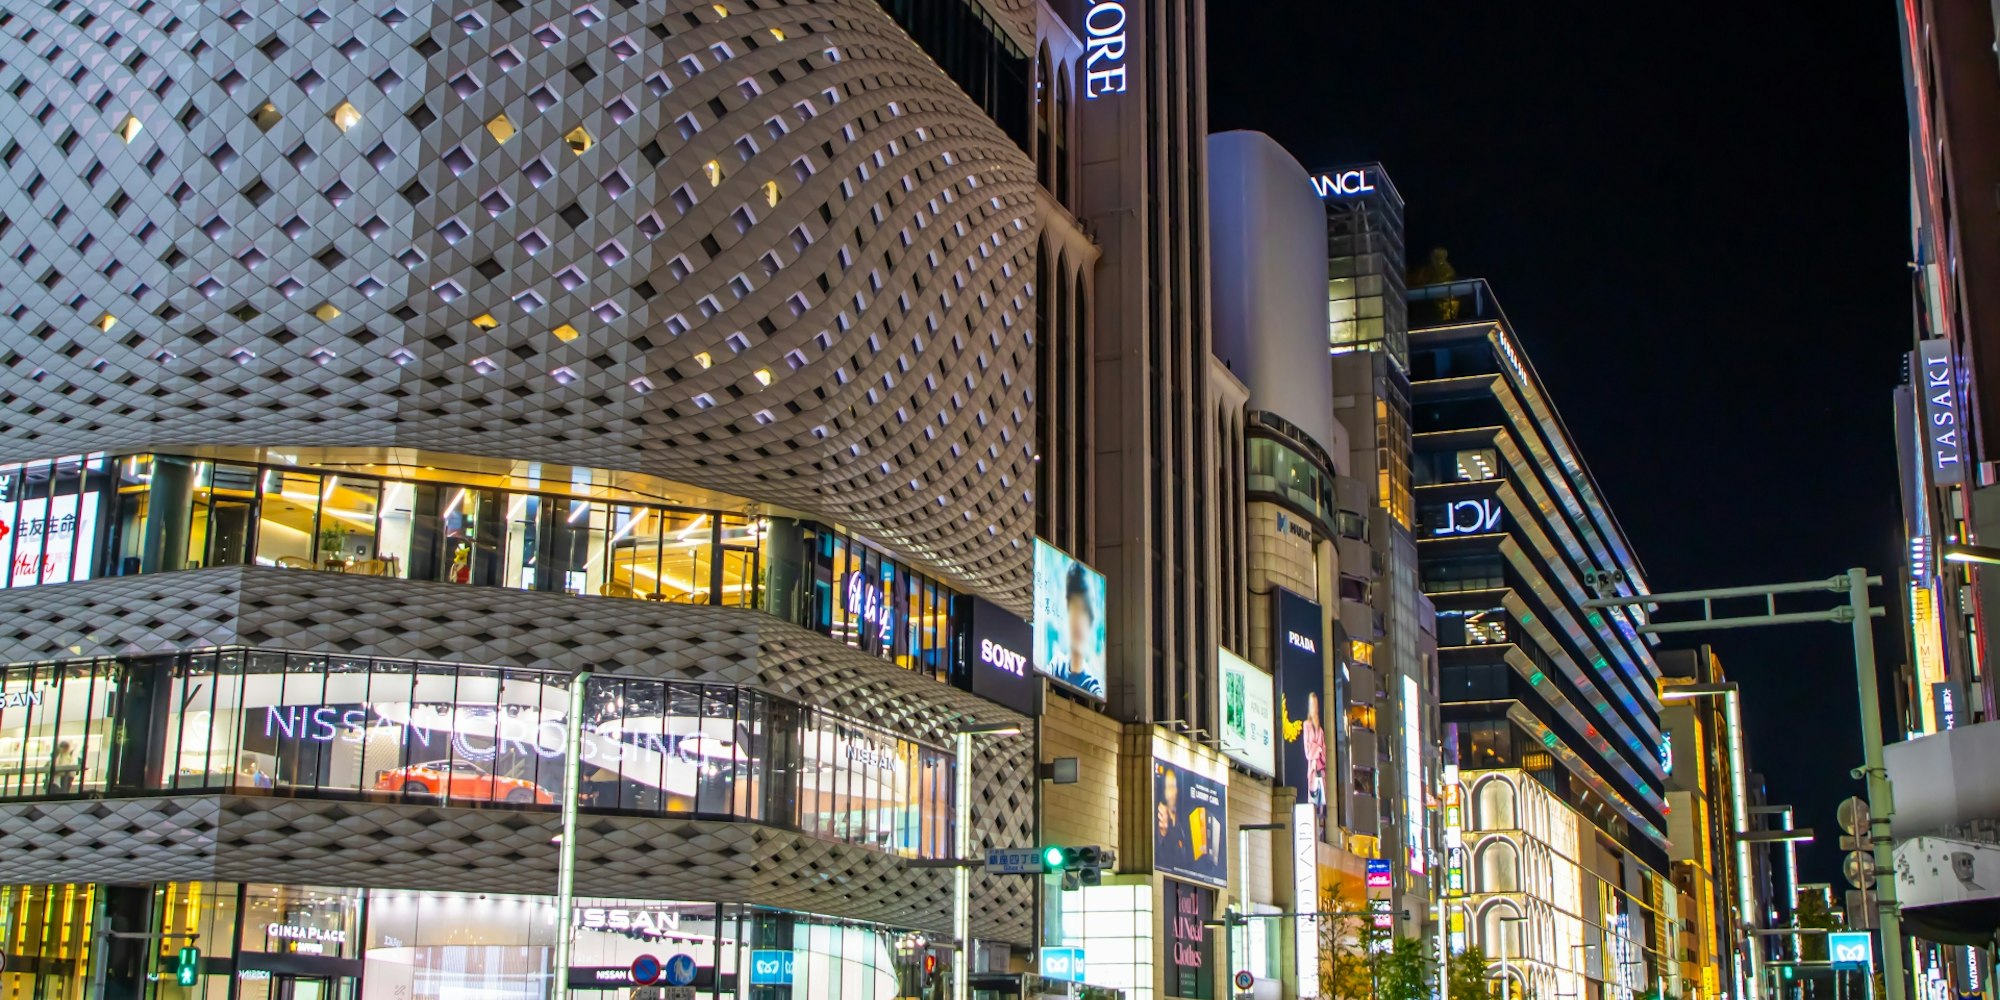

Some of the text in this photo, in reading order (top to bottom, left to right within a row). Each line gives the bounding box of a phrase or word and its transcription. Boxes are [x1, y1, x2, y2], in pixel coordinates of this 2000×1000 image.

[1085, 0, 1127, 99] ORE
[1928, 355, 1960, 469] TASAKI
[1289, 630, 1317, 654] PRADA
[981, 638, 1027, 677] SONY
[264, 703, 710, 770] NISSAN CROSSING
[845, 744, 896, 773] NISSAN
[268, 923, 346, 942] GINZA PLACE
[1174, 942, 1202, 968] Clothes
[596, 970, 627, 981] NISSAN
